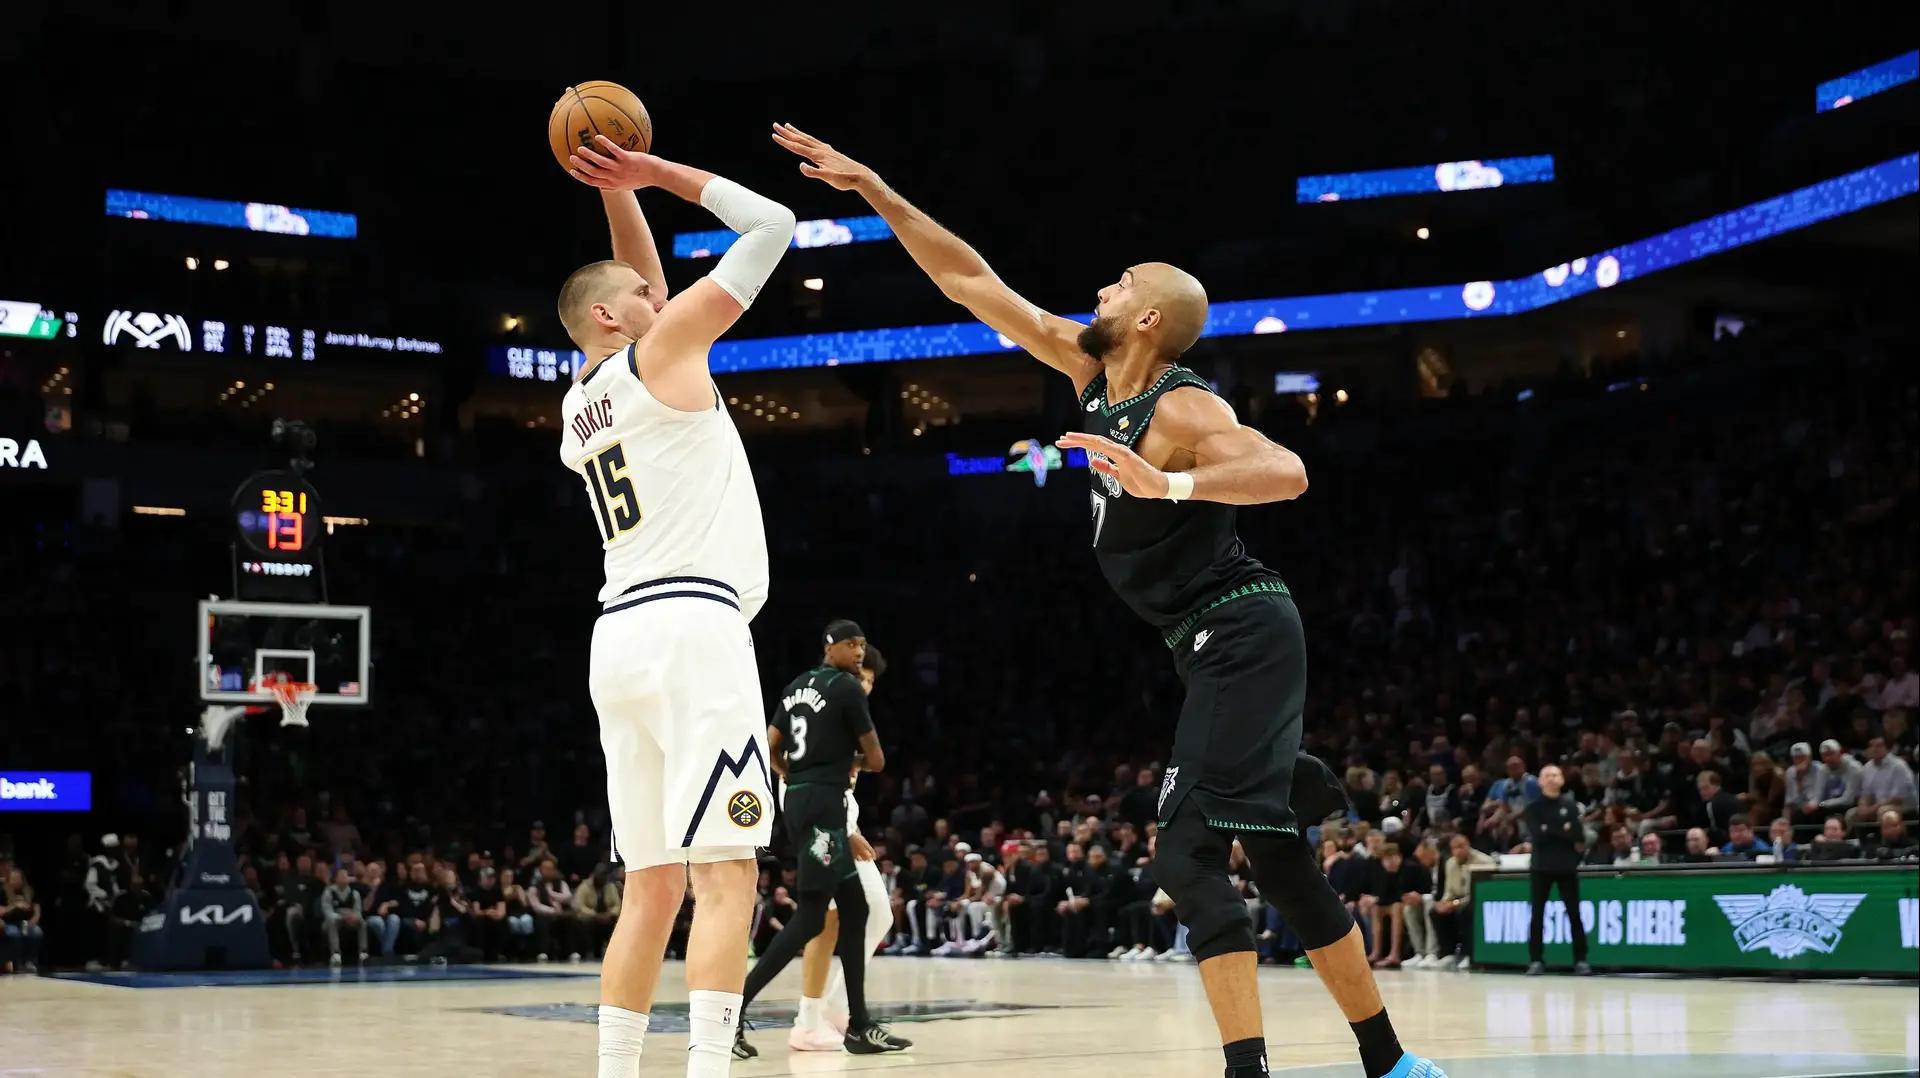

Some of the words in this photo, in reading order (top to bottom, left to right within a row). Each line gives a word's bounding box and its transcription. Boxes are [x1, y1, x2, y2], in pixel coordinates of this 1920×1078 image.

[507, 347, 534, 364] CLE
[508, 361, 534, 378] TOR
[571, 393, 613, 448] JOKIĆ
[0, 437, 49, 469] RA
[261, 489, 308, 515] 3:31
[583, 440, 644, 544] 15
[268, 511, 303, 550] 13
[261, 562, 314, 577] TISSOT
[788, 713, 808, 761] 3
[1482, 901, 1595, 944] WINSTP
[1598, 900, 1623, 945] IS
[1626, 900, 1687, 946] HERE
